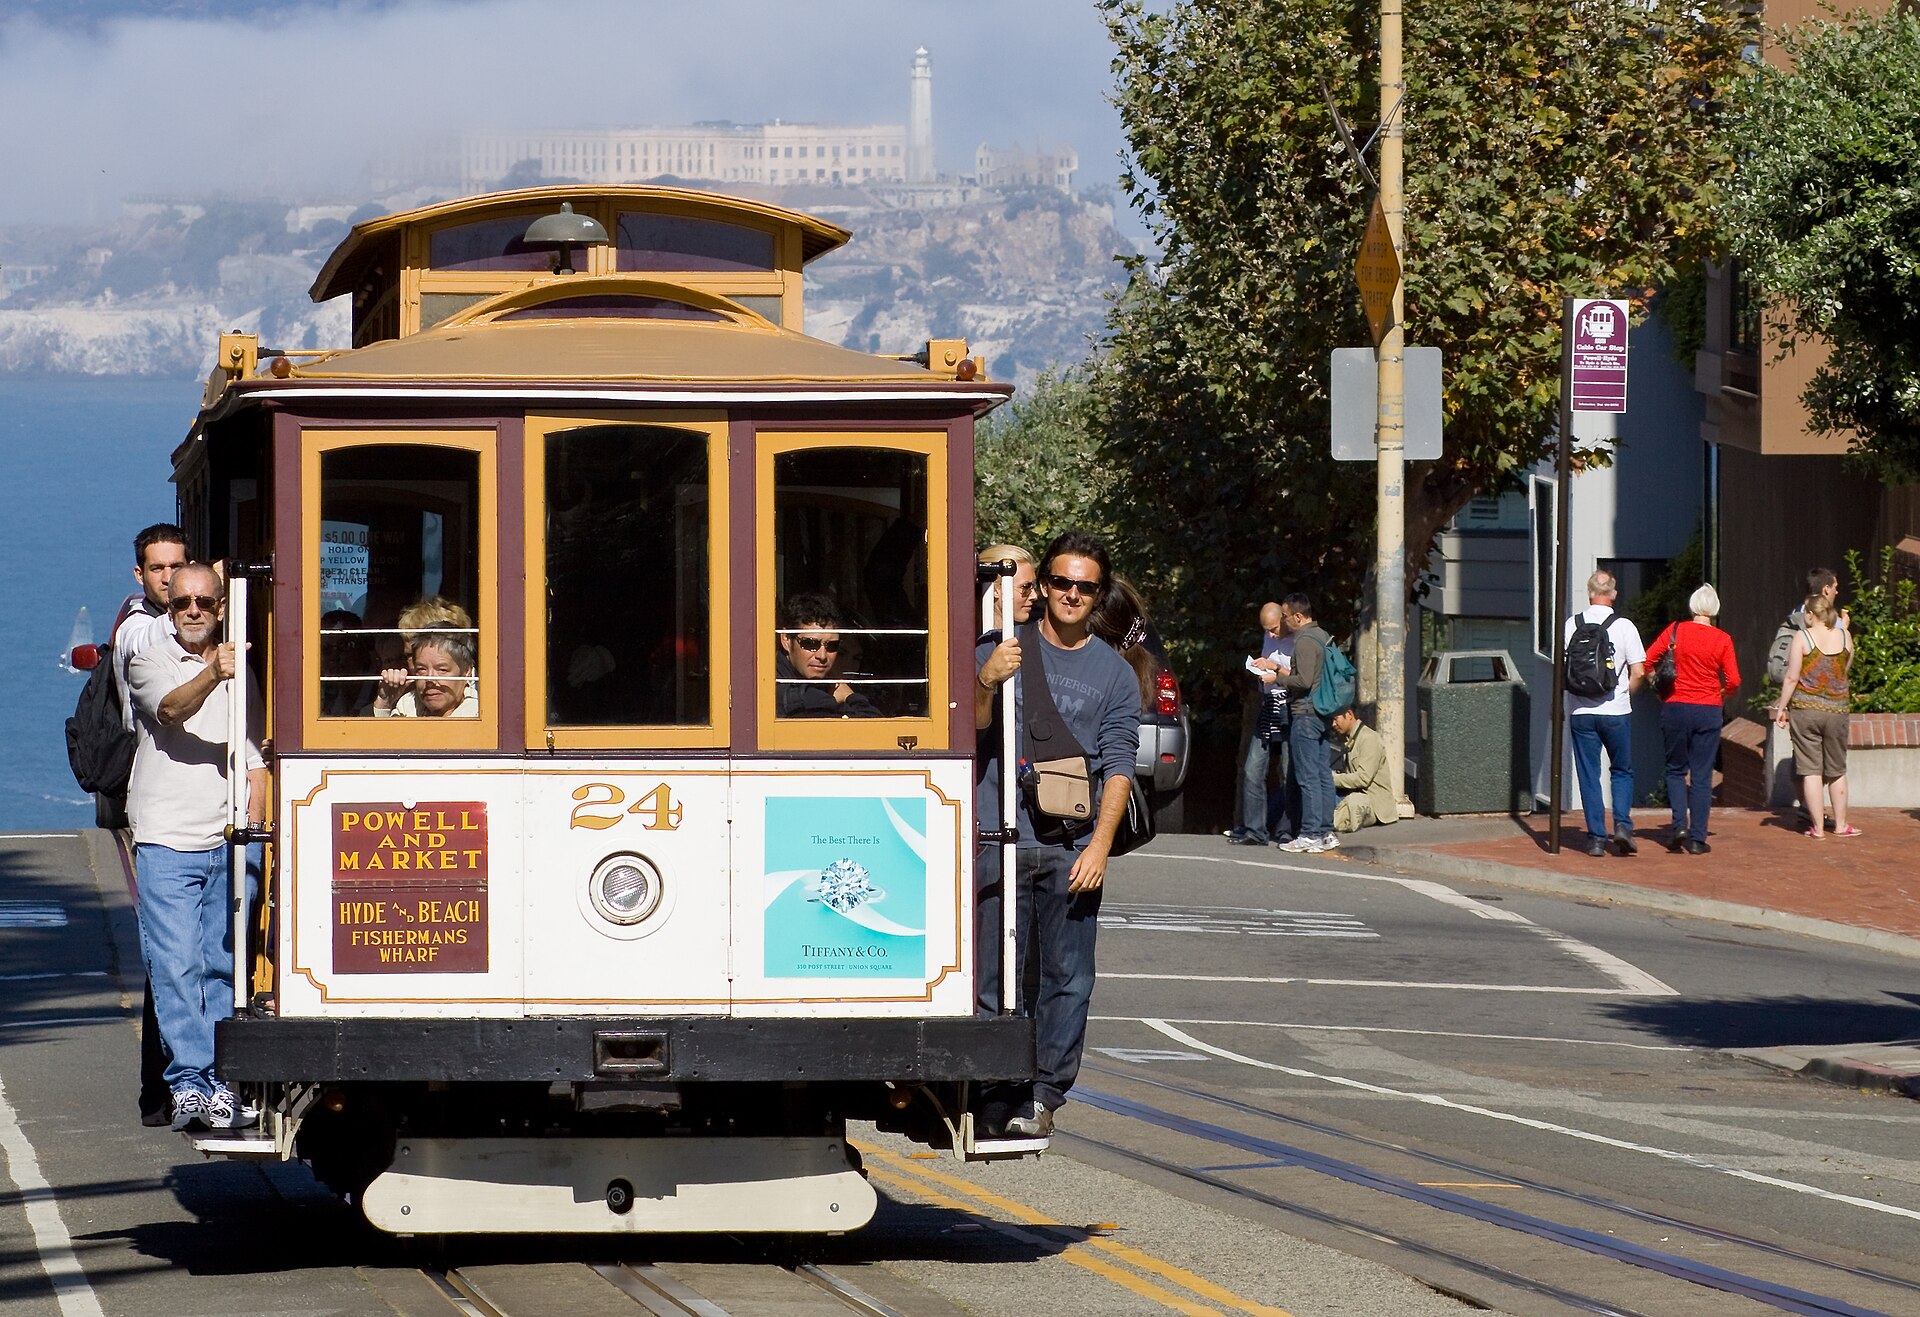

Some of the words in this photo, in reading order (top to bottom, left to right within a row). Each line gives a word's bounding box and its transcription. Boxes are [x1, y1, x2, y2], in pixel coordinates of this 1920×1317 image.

[1361, 265, 1373, 282] FOR
[1375, 265, 1395, 284] CROSS
[328, 546, 354, 554] HOLD
[328, 556, 365, 564] YELLOW
[1045, 672, 1105, 703] NIVERSITY
[570, 782, 683, 831] 24
[341, 811, 479, 832] POWELL
[378, 833, 447, 849] AND
[811, 834, 828, 845] The
[828, 835, 846, 845] Best
[847, 834, 871, 845] There
[872, 835, 880, 845] Is
[339, 850, 482, 871] MARKET
[340, 901, 387, 925] HYDE
[392, 902, 415, 923] AND
[418, 900, 480, 923] BEACH
[351, 928, 468, 946] FISHERMANS
[379, 947, 440, 963] WHARF
[869, 963, 893, 971] SQUARE
